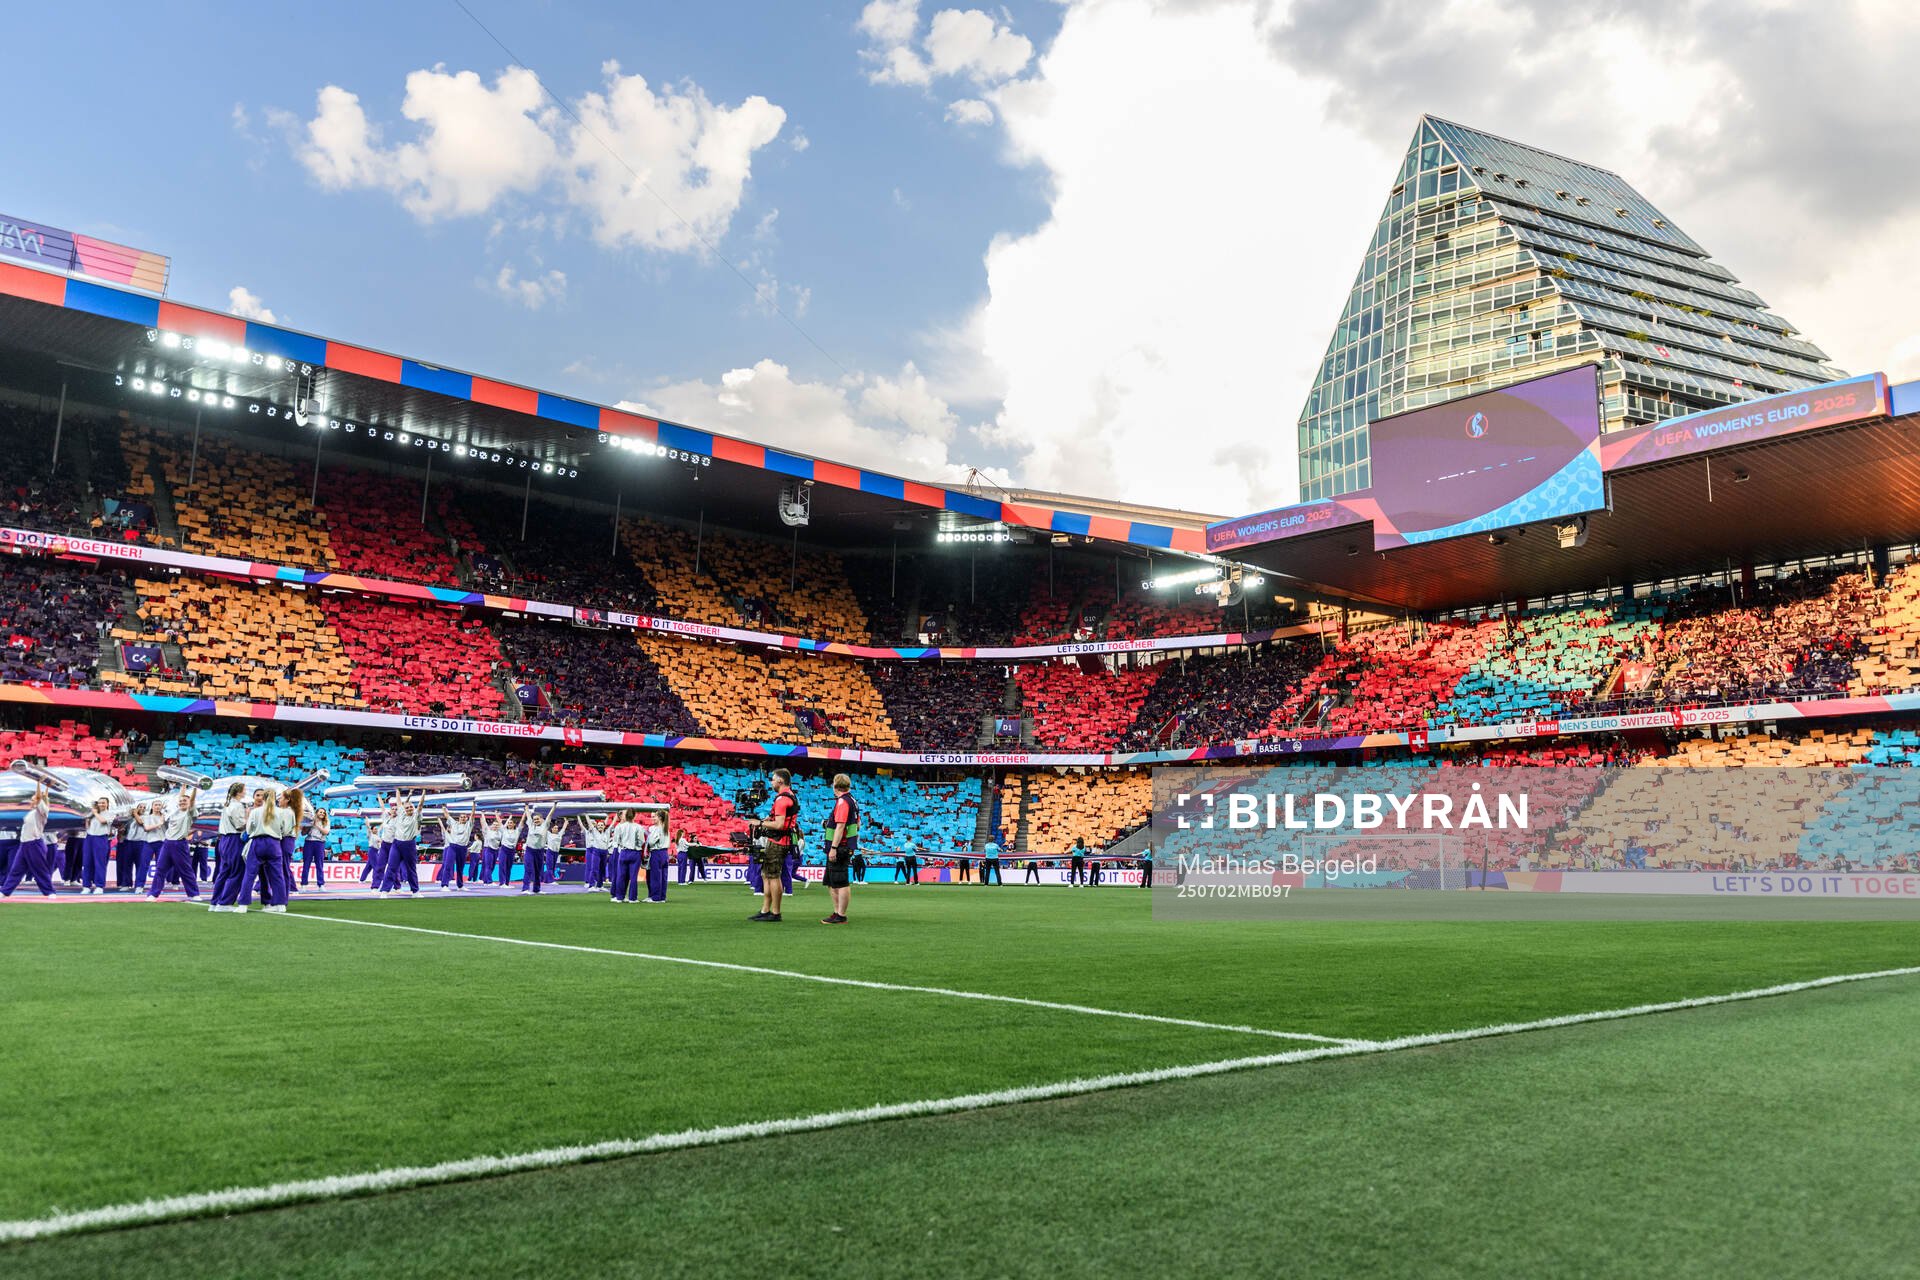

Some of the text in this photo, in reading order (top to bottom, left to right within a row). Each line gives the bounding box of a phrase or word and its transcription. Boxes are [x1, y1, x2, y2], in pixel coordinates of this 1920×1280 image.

[1655, 393, 1856, 448] UEFA WOMEN'S EURO 2025
[1214, 509, 1332, 542] UEFA WOMEN'S EURO 2025
[16, 533, 38, 544] DO
[60, 539, 142, 559] OGETHER!
[662, 621, 671, 629] IT
[673, 622, 720, 636] TOGETHER!
[1057, 641, 1156, 653] LET'S DO IT TOGETHER!
[518, 690, 529, 698] C5
[404, 716, 438, 728] LET'S
[441, 720, 459, 731] DO
[462, 722, 474, 732] IT
[1516, 711, 1730, 734] UEF MEN'S EURO SWITZERLND 2025
[1259, 744, 1283, 753] BASEL
[919, 754, 946, 763] LET'S
[948, 755, 962, 763] DO
[964, 755, 974, 763] IT
[289, 865, 361, 880] GETHER!
[1060, 871, 1089, 883] LETS
[1109, 872, 1119, 883] IT
[1121, 872, 1178, 884] TOGTHE
[1713, 876, 1920, 895] LET'S DO IT TOGE
